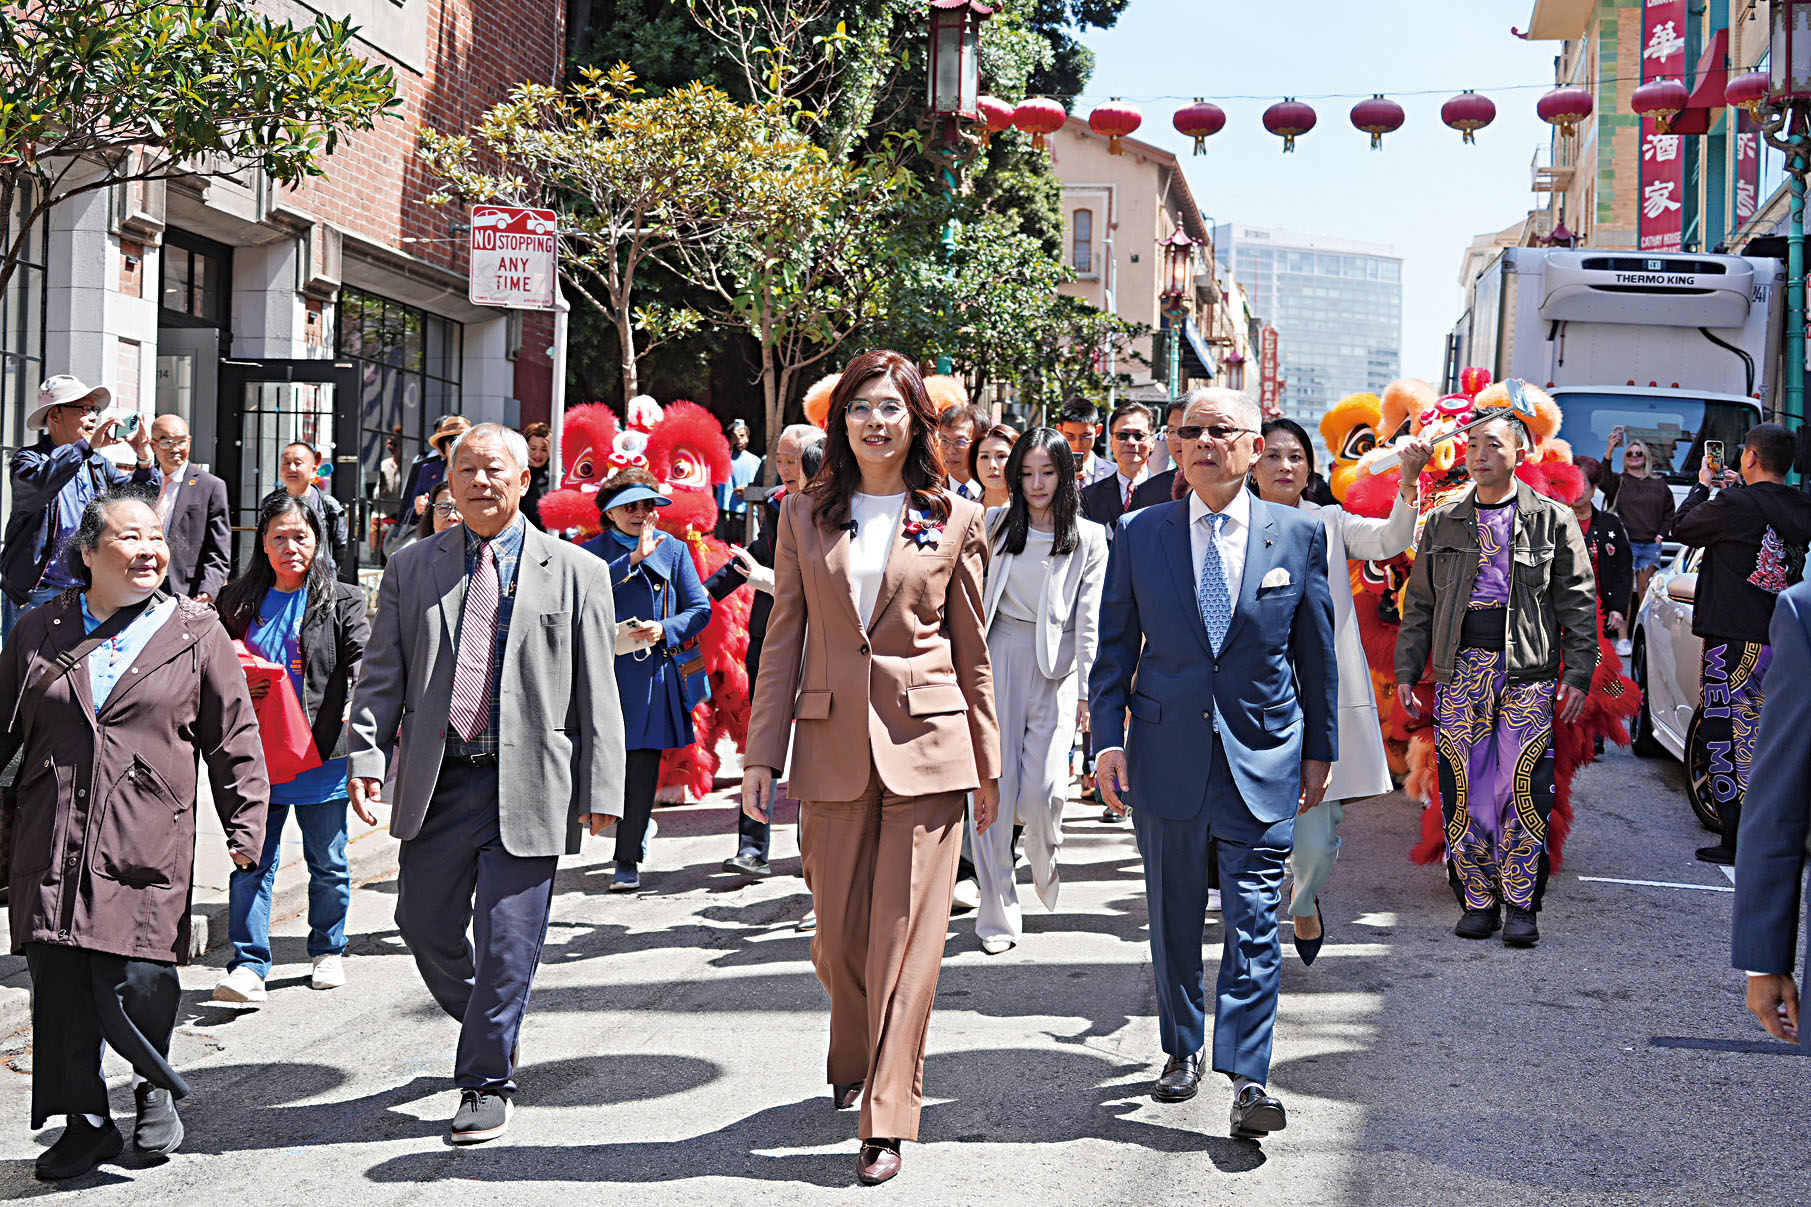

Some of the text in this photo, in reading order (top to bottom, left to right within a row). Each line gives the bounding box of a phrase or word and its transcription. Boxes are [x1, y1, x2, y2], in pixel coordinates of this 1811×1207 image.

[474, 229, 552, 252] NO STOPPING
[1641, 235, 1662, 248] CATHAY
[498, 257, 529, 273] ANY
[496, 275, 531, 292] TIME
[1616, 274, 1695, 285] THERMO KING
[1704, 643, 1738, 803] WEI MO
